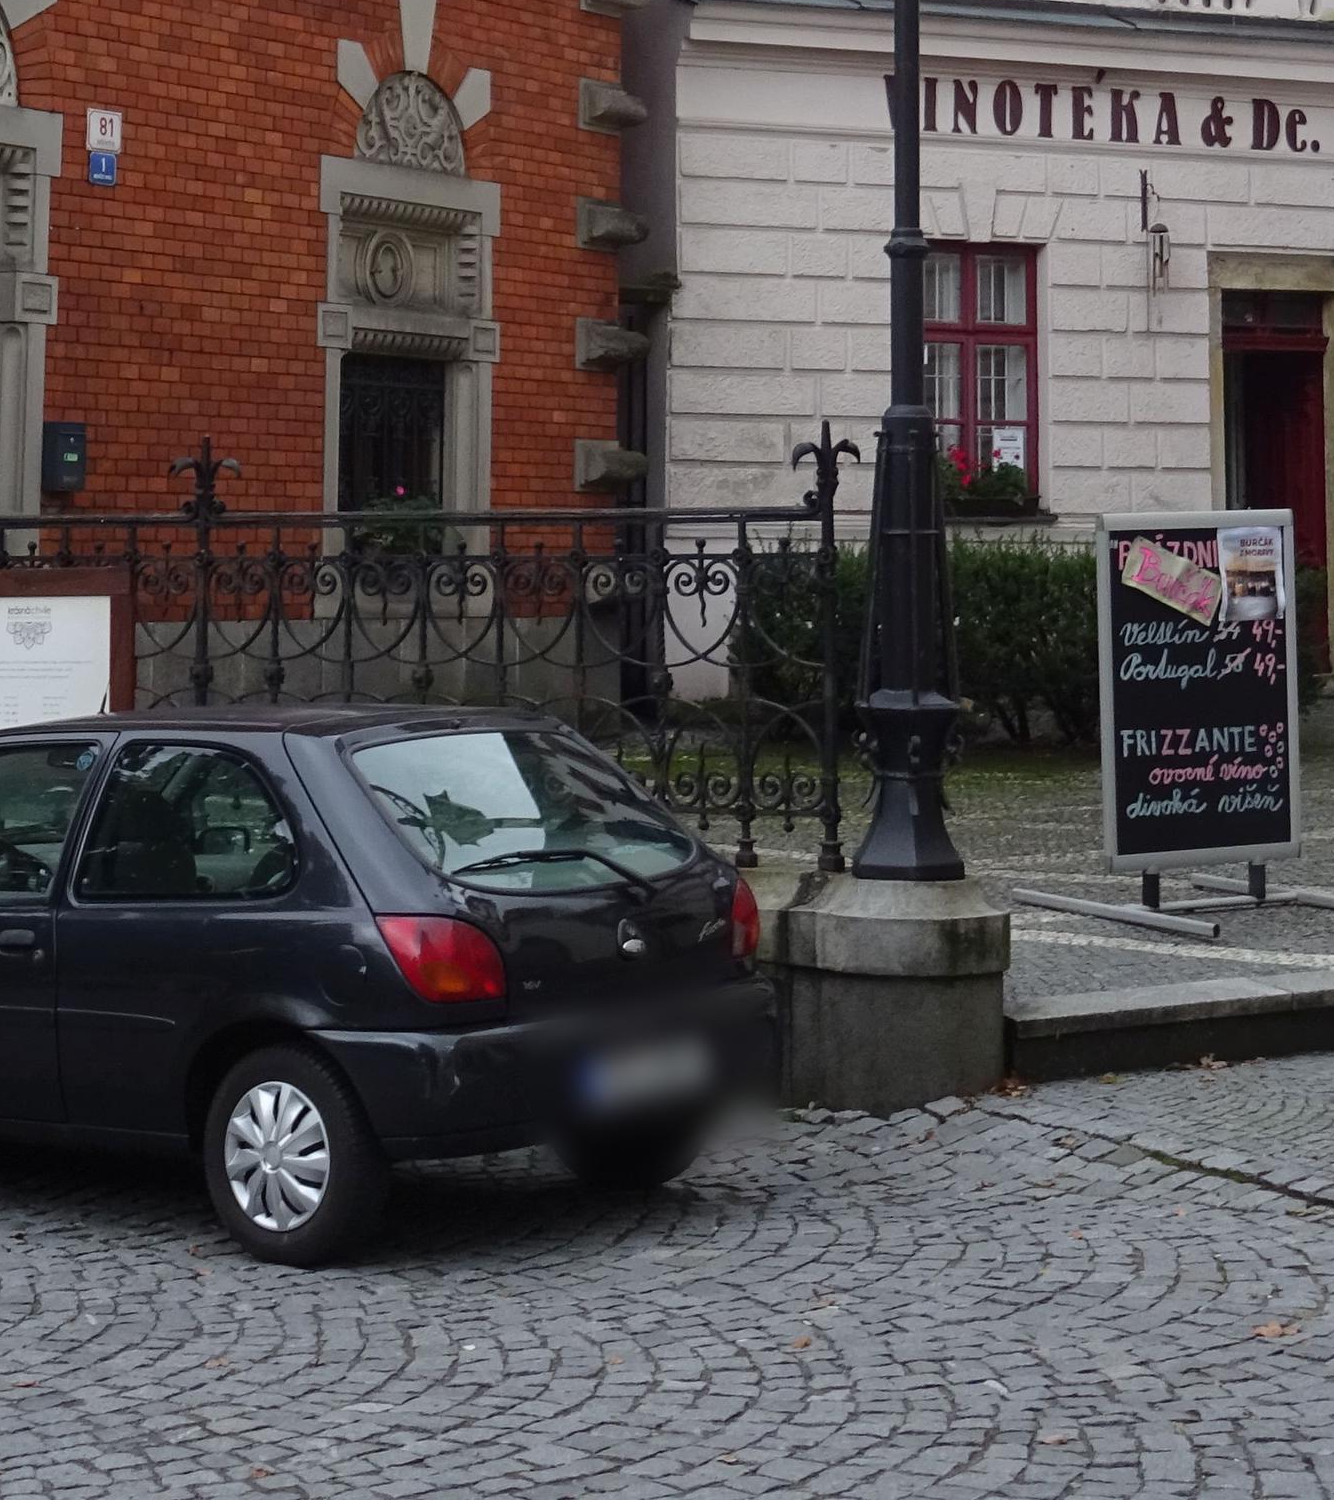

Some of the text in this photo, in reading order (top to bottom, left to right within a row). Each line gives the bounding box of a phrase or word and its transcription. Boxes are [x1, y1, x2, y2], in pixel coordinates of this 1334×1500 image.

[99, 116, 114, 138] 81
[1201, 97, 1234, 149] &
[1240, 536, 1274, 548] BURČÁK
[1119, 648, 1217, 690] Portugal
[1120, 725, 1258, 758] FRIZZANTE
[1148, 754, 1269, 786] ovocné víno
[1126, 783, 1284, 819] divoká višeň
